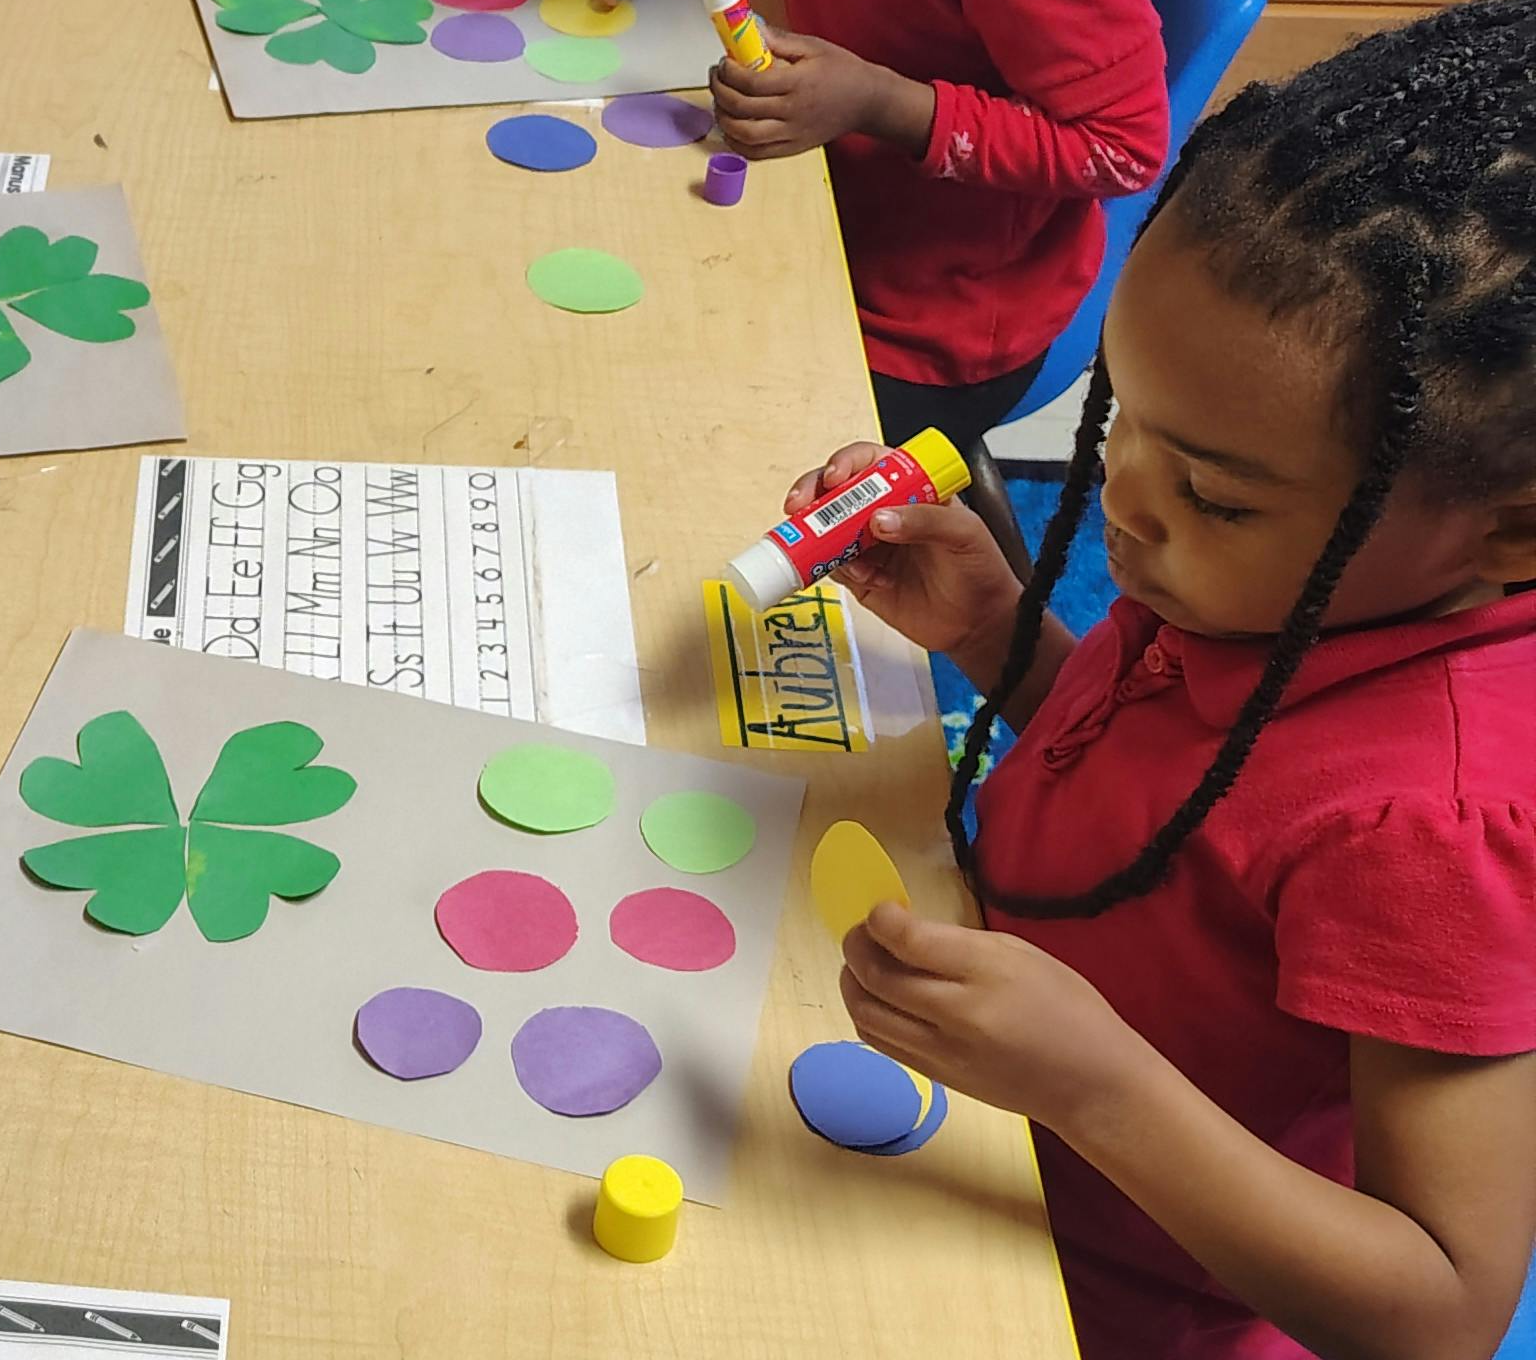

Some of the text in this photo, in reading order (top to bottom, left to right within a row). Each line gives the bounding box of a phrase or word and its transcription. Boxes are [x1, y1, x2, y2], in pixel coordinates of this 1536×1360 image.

[212, 464, 281, 508] Gg
[469, 472, 495, 490] 0
[288, 467, 341, 514] Oo
[470, 498, 496, 511] 9
[208, 517, 264, 547] Ff
[472, 522, 499, 533] 8
[287, 527, 341, 559] Nn
[473, 545, 500, 556] 7
[205, 560, 263, 596] Ee
[365, 470, 424, 688] Ss Tt Uu Vv Ww
[474, 568, 502, 581] 6
[286, 573, 341, 618] Mm
[475, 593, 503, 604] 5
[477, 619, 505, 630] 4
[478, 643, 507, 655] 3
[480, 669, 509, 681] 2
